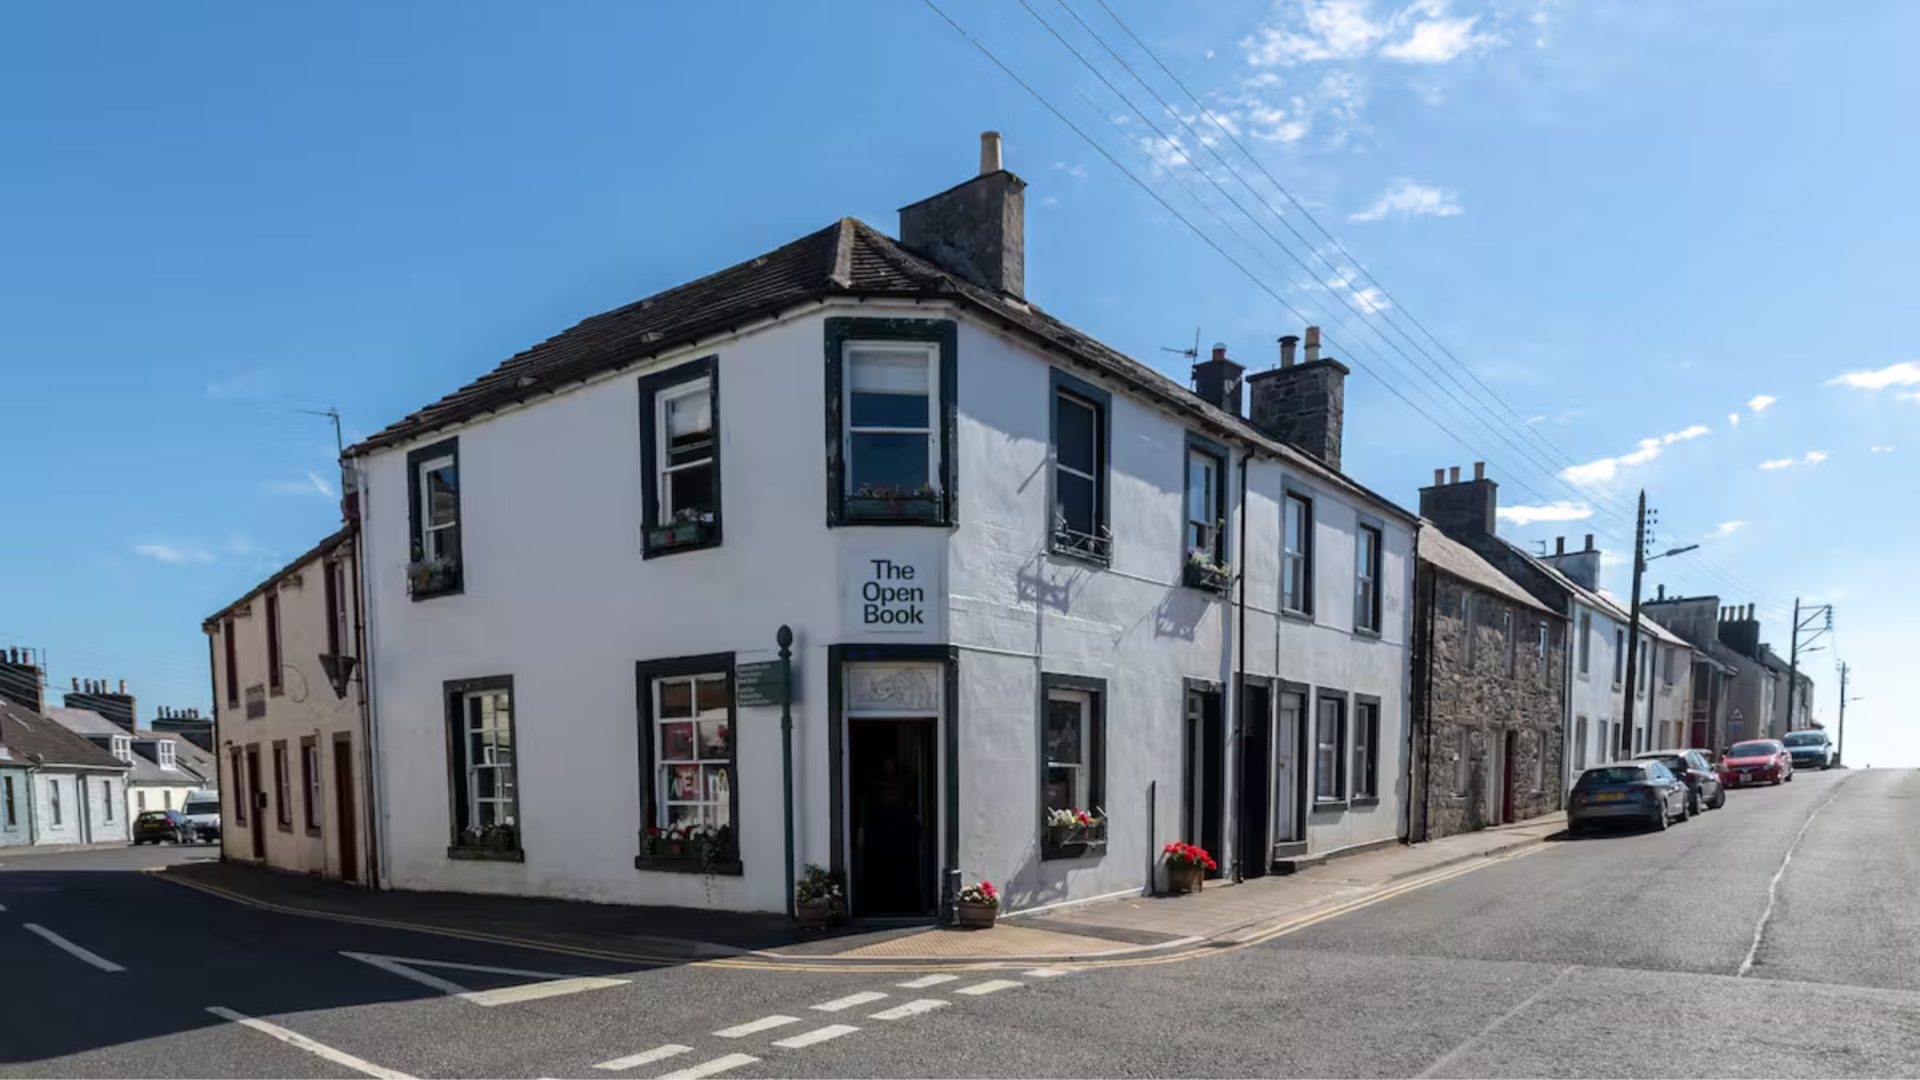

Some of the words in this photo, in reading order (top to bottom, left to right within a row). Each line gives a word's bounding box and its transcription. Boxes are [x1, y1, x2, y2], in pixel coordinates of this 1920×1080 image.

[870, 559, 915, 580] The
[862, 581, 924, 606] Open
[864, 604, 924, 624] Book
